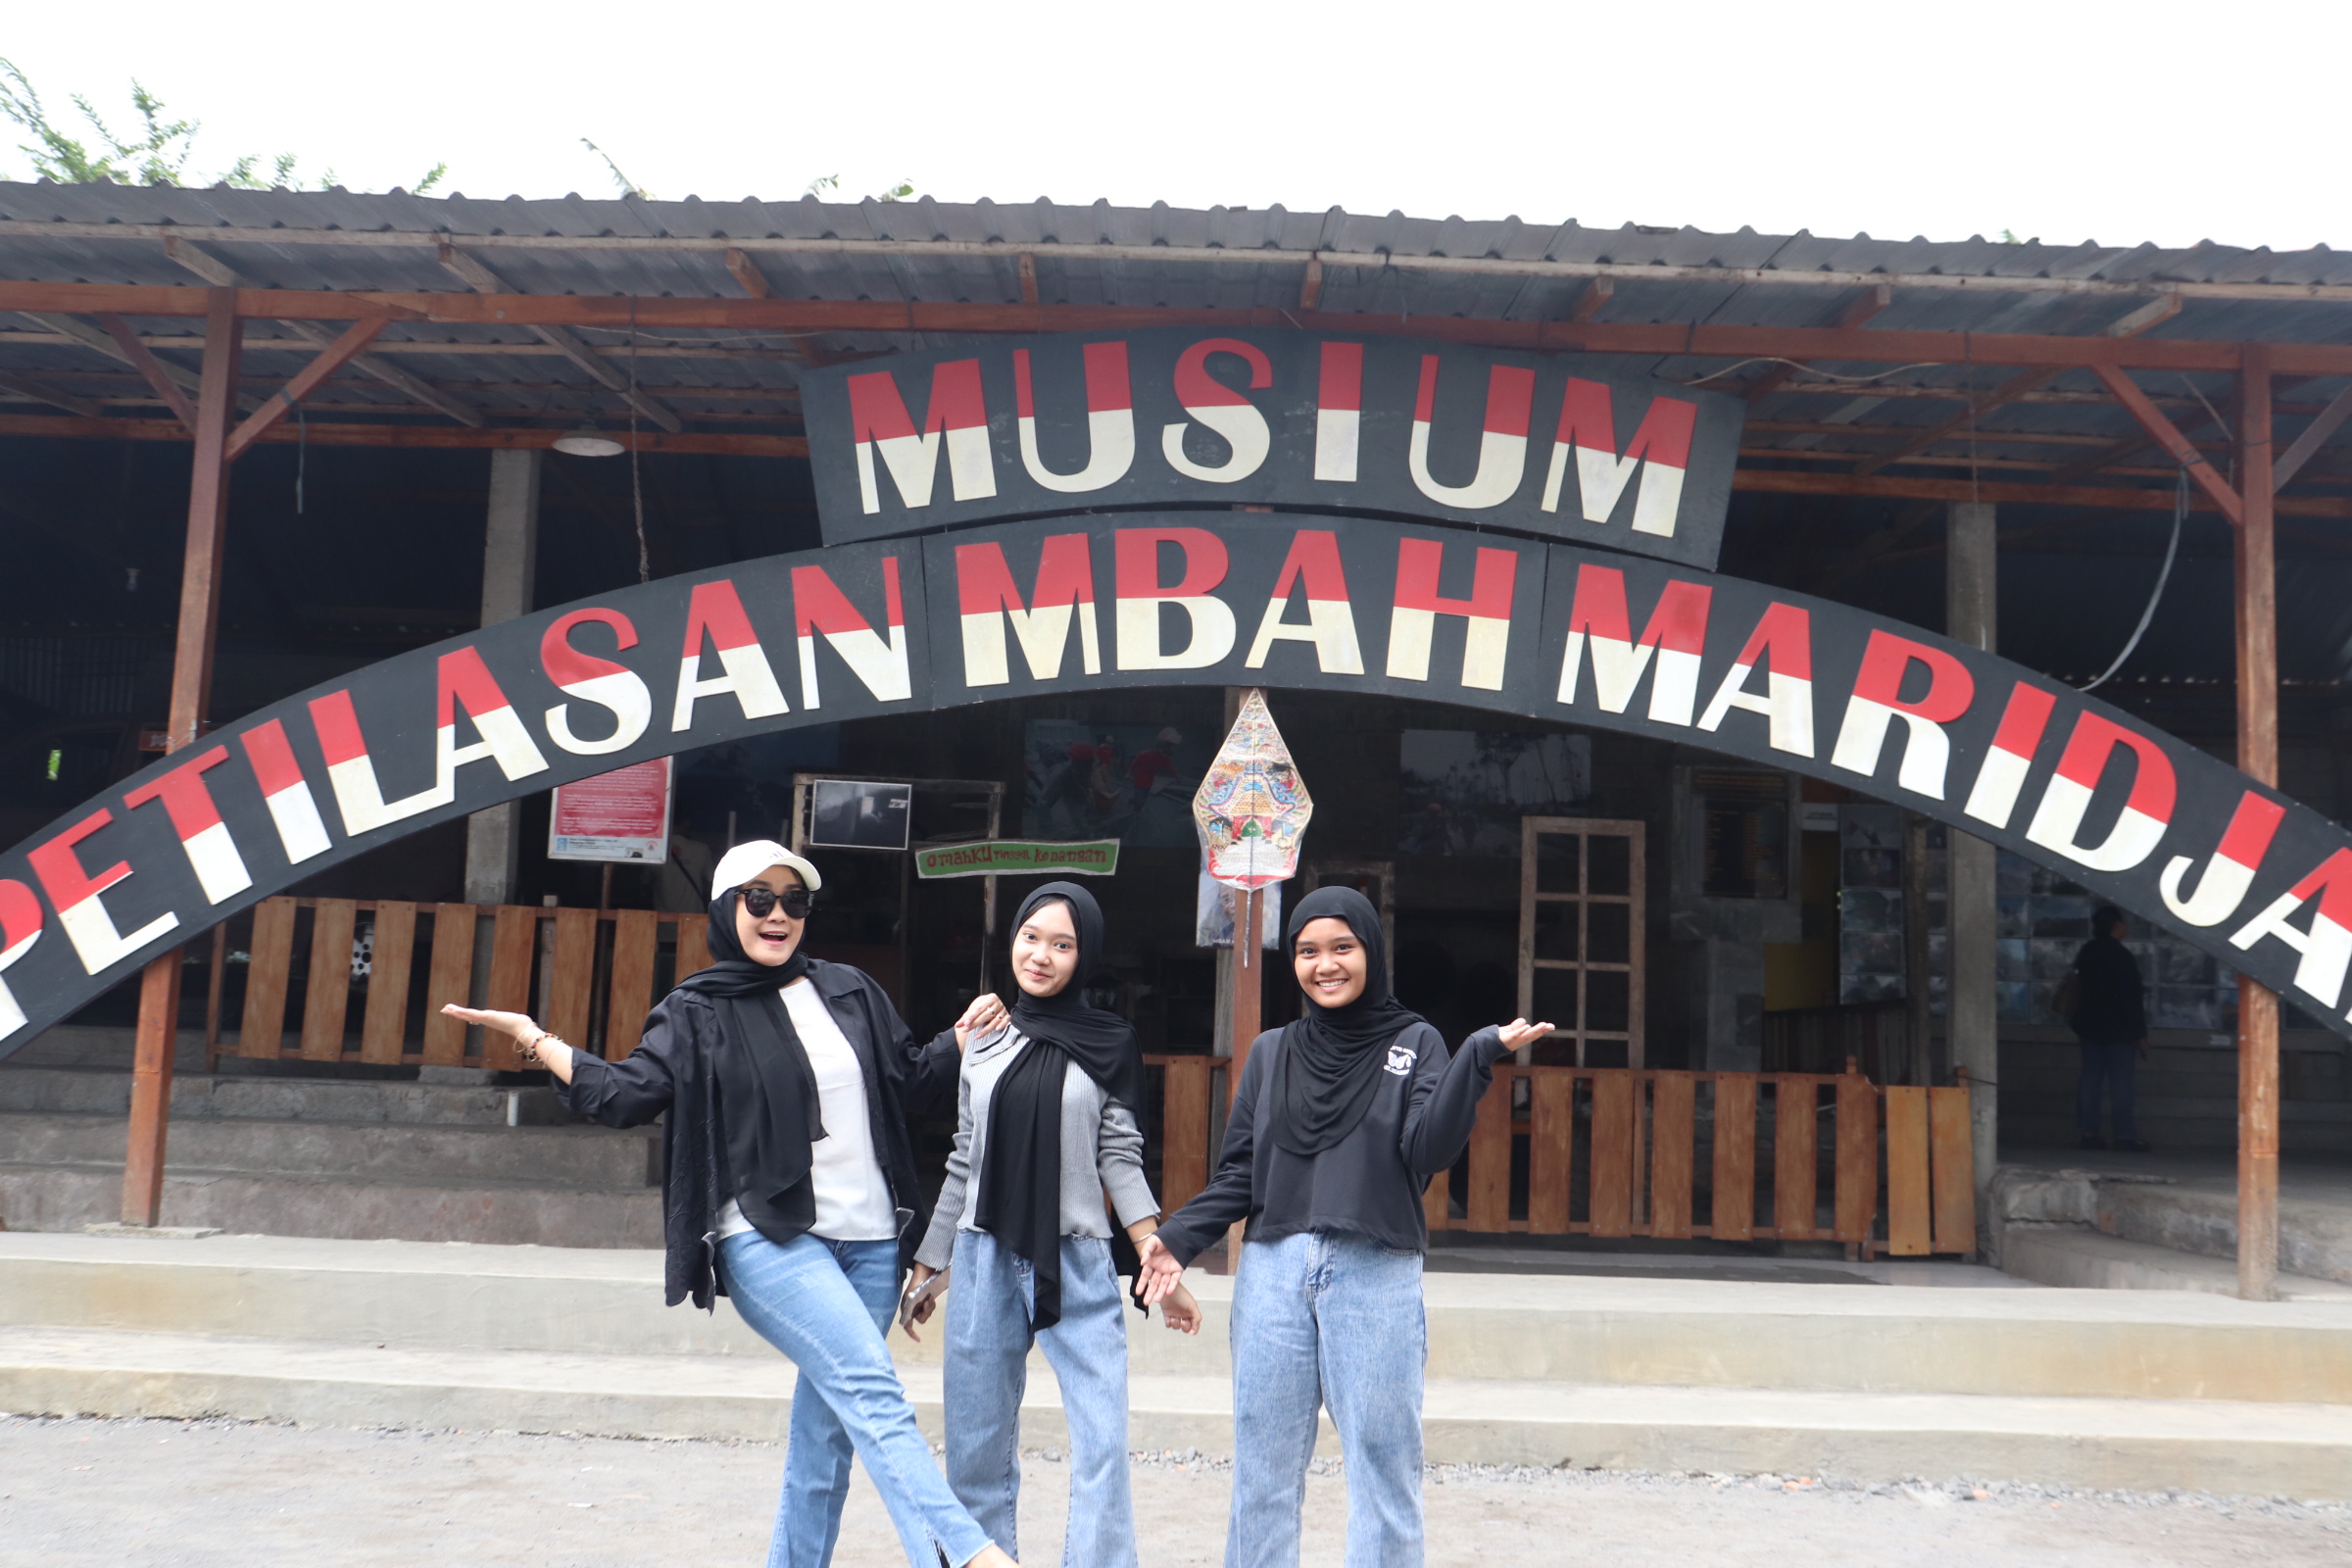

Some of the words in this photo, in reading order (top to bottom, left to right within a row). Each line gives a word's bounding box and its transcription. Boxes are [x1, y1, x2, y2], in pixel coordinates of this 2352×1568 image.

[848, 338, 1698, 538] MUSIUM
[955, 526, 1518, 691] MBAH
[1556, 563, 2352, 1026] MARIDJA
